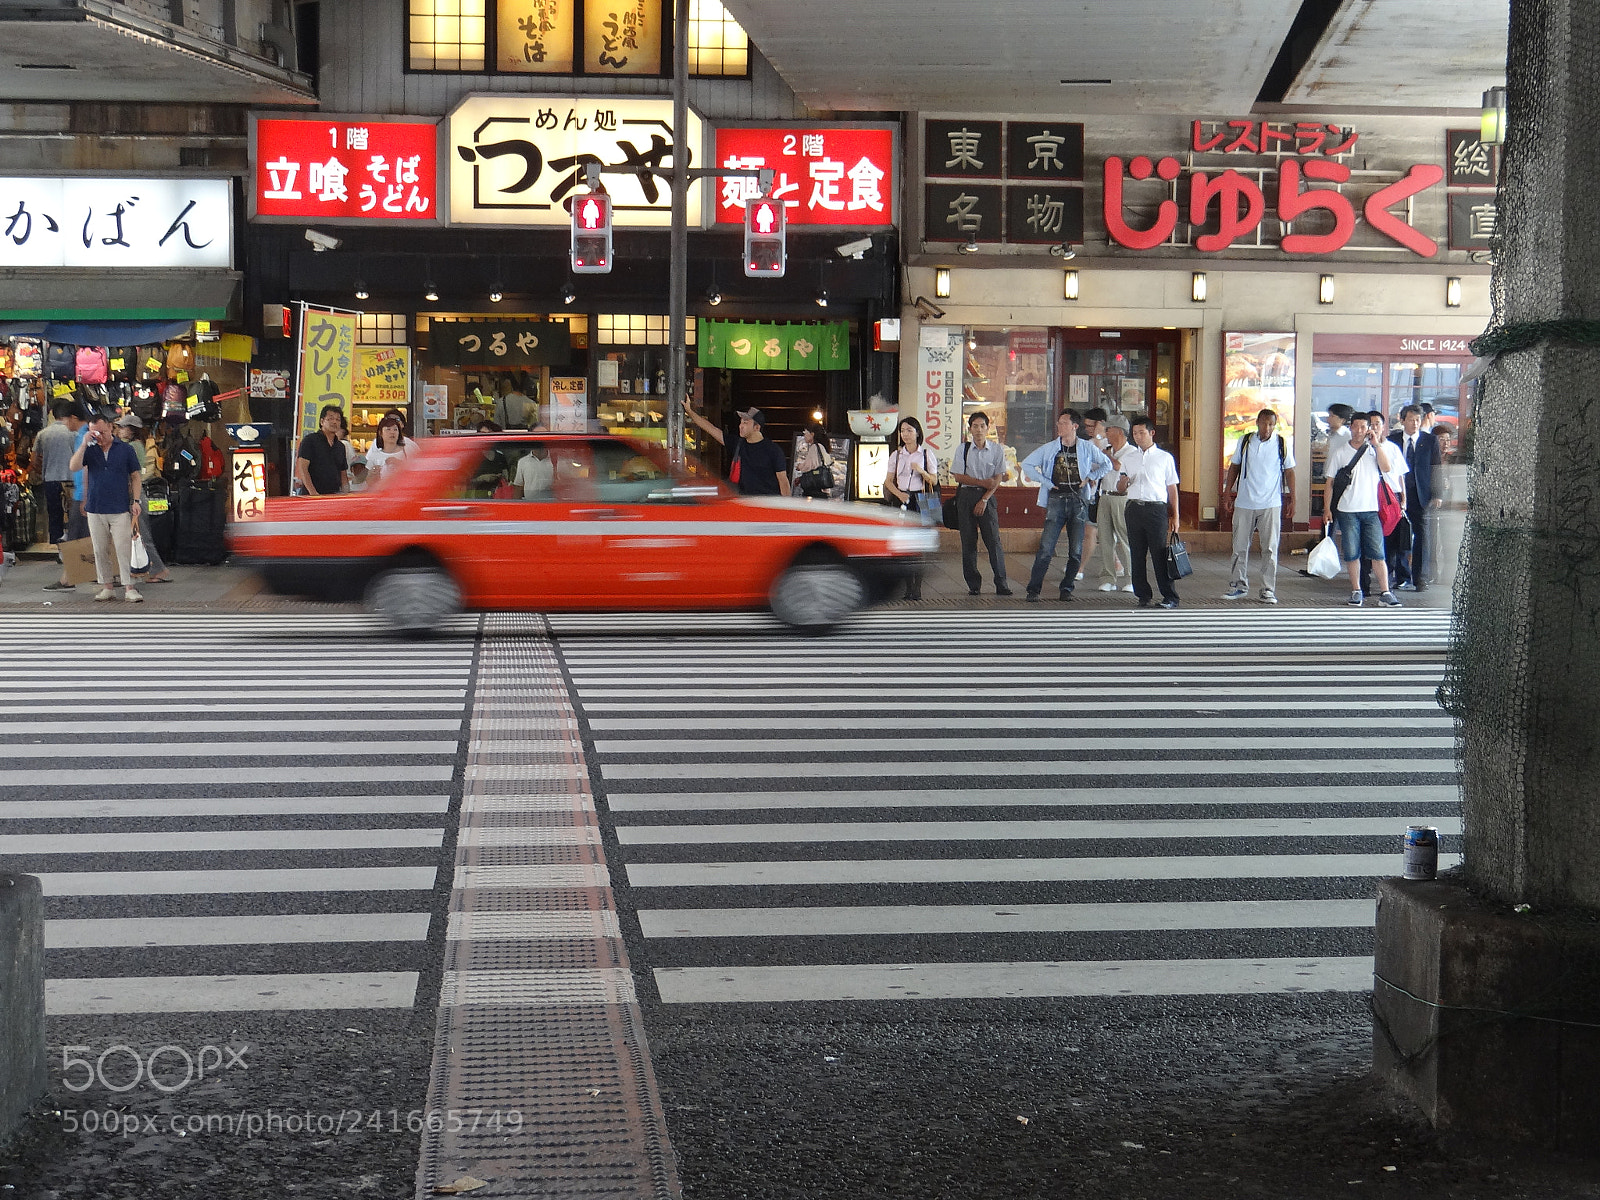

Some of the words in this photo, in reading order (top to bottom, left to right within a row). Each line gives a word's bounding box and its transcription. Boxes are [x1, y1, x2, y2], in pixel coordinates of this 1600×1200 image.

[518, 15, 548, 63] そば
[599, 12, 628, 69] うどん
[535, 108, 617, 131] めん処
[328, 127, 369, 150] 1階
[782, 134, 825, 157] 2階
[1193, 120, 1359, 155] レストラン
[263, 156, 350, 203] 立喰
[365, 154, 421, 183] そば
[358, 184, 430, 213] うどん
[1103, 155, 1445, 258] じゅらく
[5, 196, 214, 249] かばん
[458, 331, 539, 356] つるや
[730, 338, 814, 358] つるや
[1400, 338, 1436, 351] SINCE
[1440, 339, 1466, 352] 1924
[379, 389, 406, 400] 550円
[925, 370, 942, 450] じゅらく
